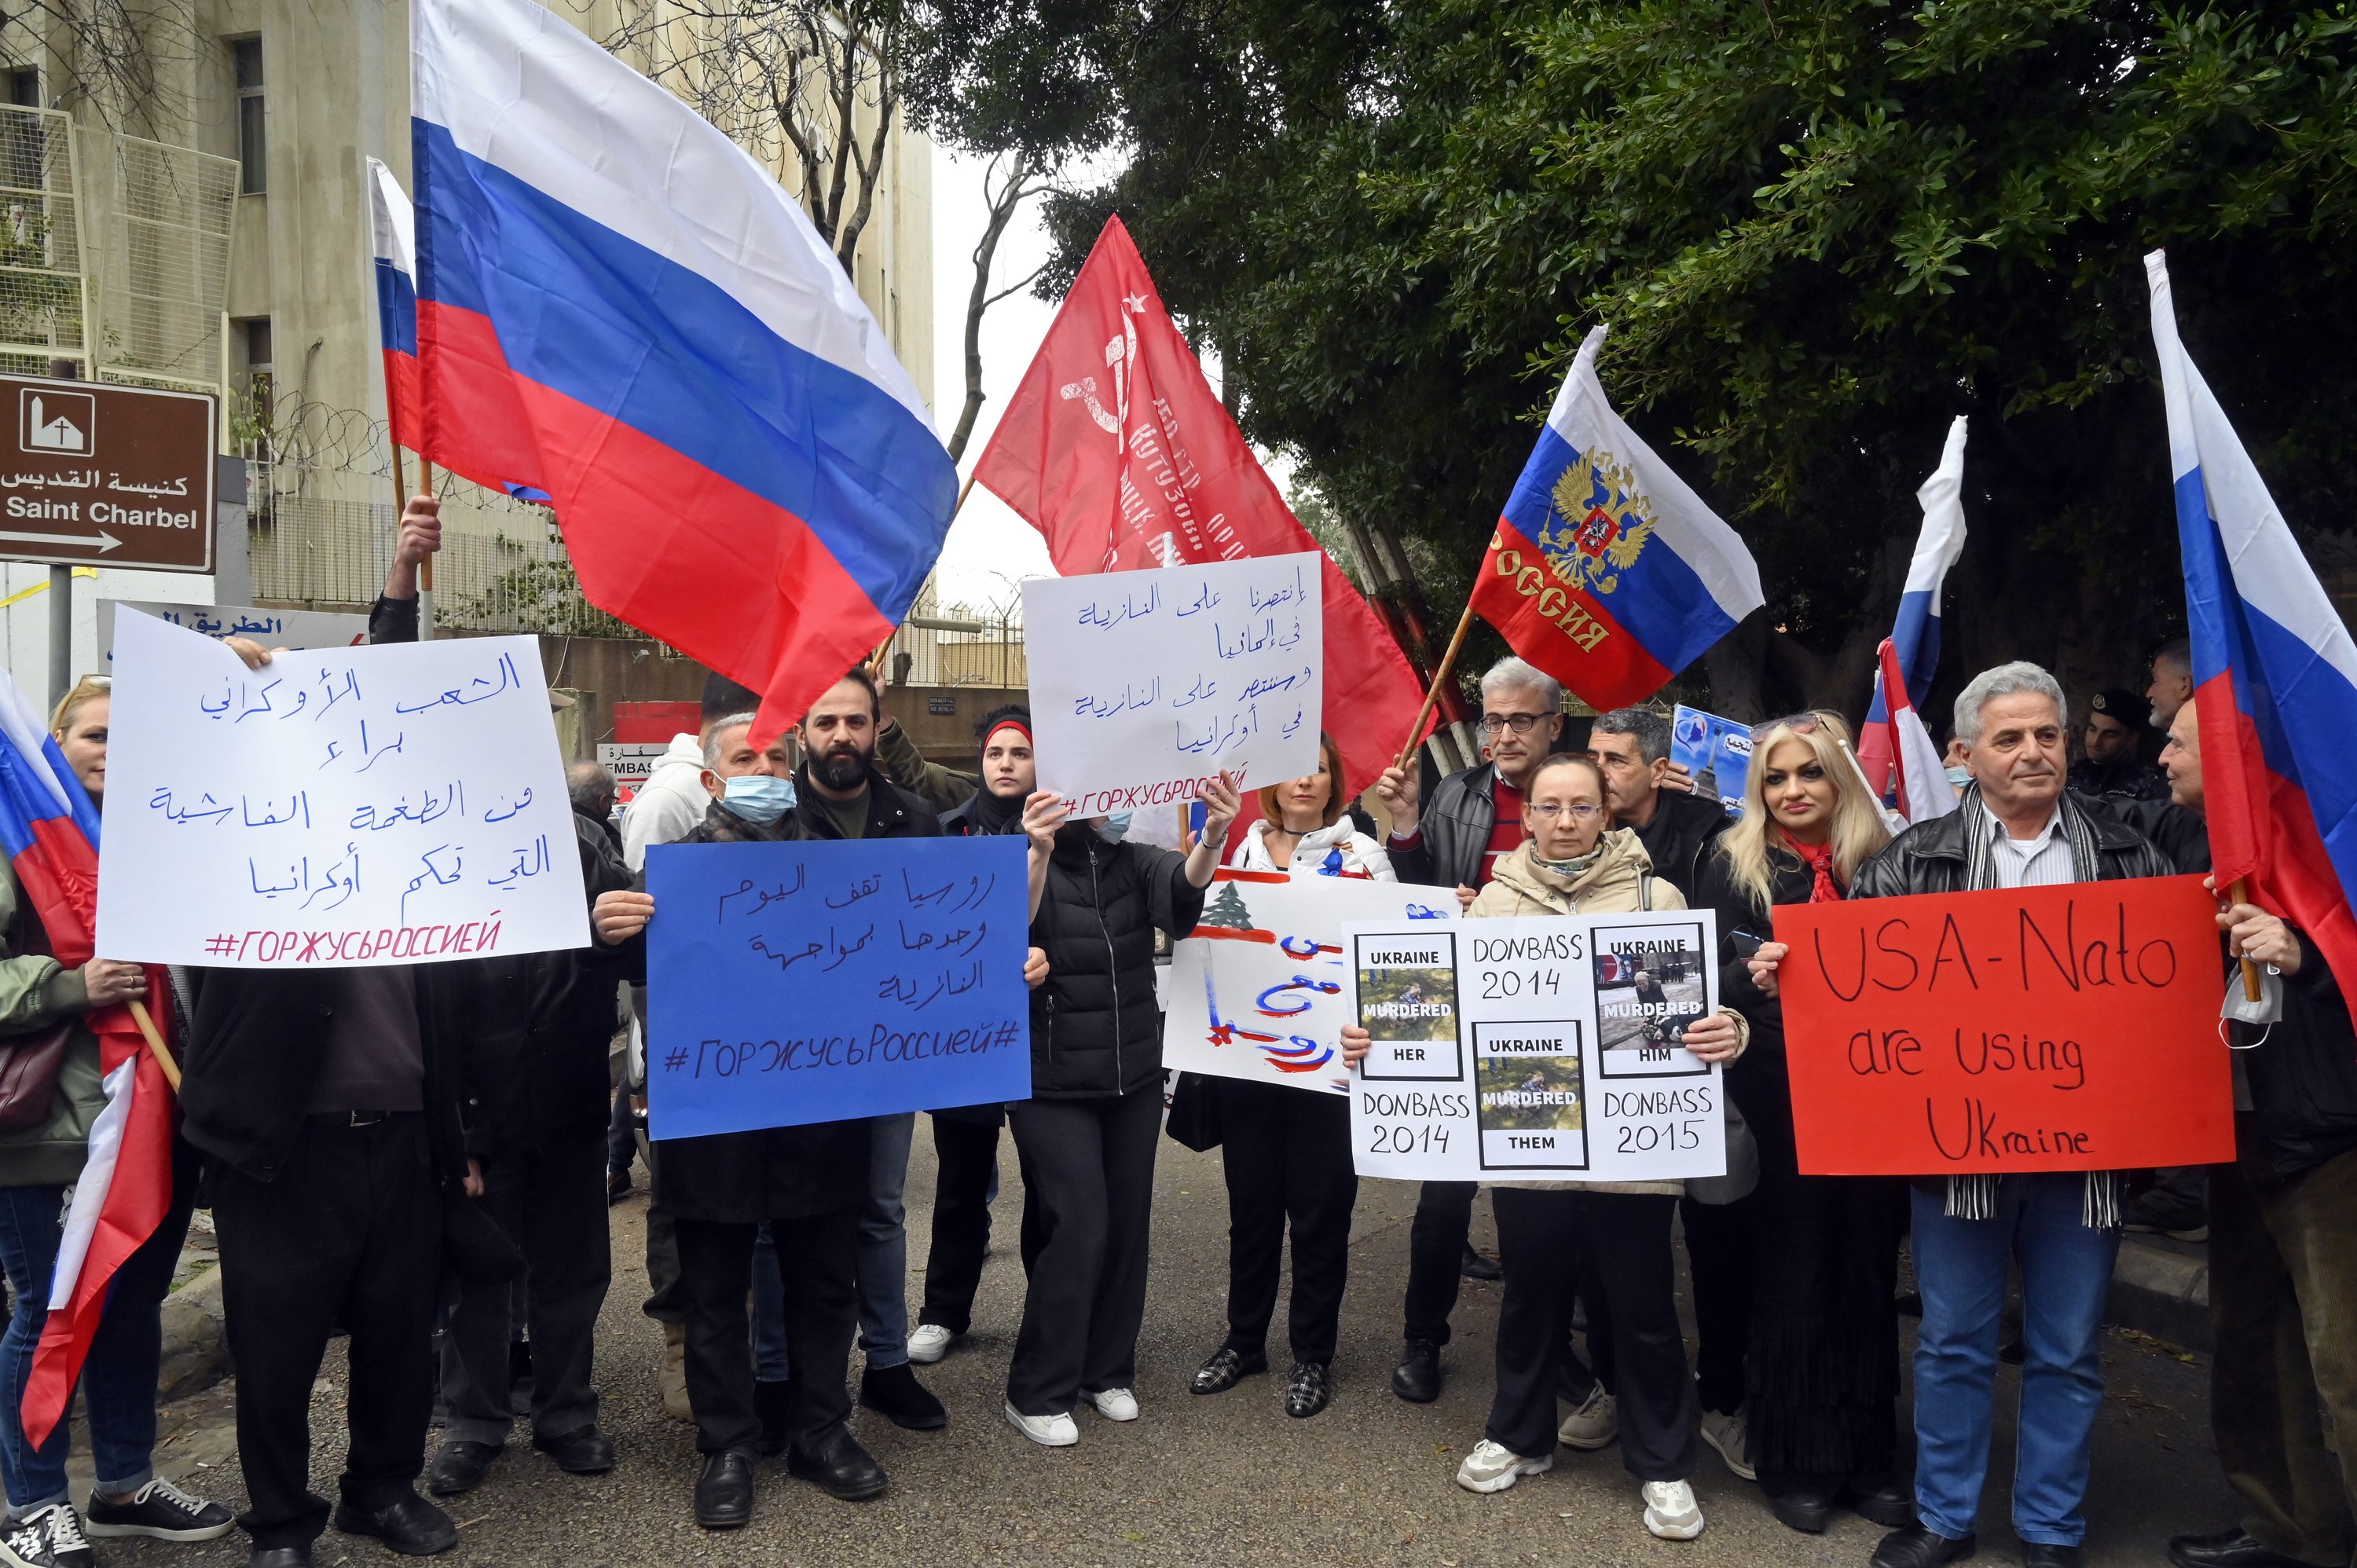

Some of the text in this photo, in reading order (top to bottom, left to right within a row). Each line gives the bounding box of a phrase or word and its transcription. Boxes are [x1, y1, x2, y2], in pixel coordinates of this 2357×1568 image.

[1, 469, 188, 499] كنيسة القديس
[6, 496, 196, 529] Saint Charbel
[1206, 513, 1252, 560] ОРД
[1079, 582, 1161, 631] النازية
[1176, 582, 1221, 617] على
[189, 612, 281, 638] الطريق
[1279, 616, 1300, 652] في
[396, 653, 520, 714] الشعب
[1076, 676, 1161, 718] النازية
[1172, 674, 1217, 707] على
[1281, 704, 1302, 739] في
[610, 746, 665, 760] فارة
[150, 781, 533, 831] من الطغمة الفاشية
[250, 835, 550, 932] التي تحكم أوكرانيا
[719, 863, 995, 925] روسيا تقف اليوم
[205, 910, 502, 962] #ГОРЖУСЬРОССИЕЙ
[900, 920, 987, 957] وحدها
[1474, 934, 1583, 962] DONBASS
[1611, 939, 1686, 954] UKRAINE
[1370, 951, 1439, 965] UKRAINE
[878, 960, 984, 1011] النازية
[1483, 969, 1560, 999] 2014
[1363, 1002, 1452, 1017] MURDERED
[1604, 1001, 1702, 1018] MURDERED
[1394, 1048, 1426, 1061] HER
[1489, 1039, 1563, 1053] UKRAINE
[1639, 1048, 1672, 1062] HIM
[1848, 1028, 1924, 1075] are
[1364, 1092, 1470, 1119] DONBASS
[1482, 1090, 1577, 1106] MURDERED
[1604, 1086, 1713, 1119] DONBASS
[1370, 1125, 1450, 1154] 2014
[1508, 1137, 1556, 1149] THEM
[1618, 1119, 1706, 1154] 2015
